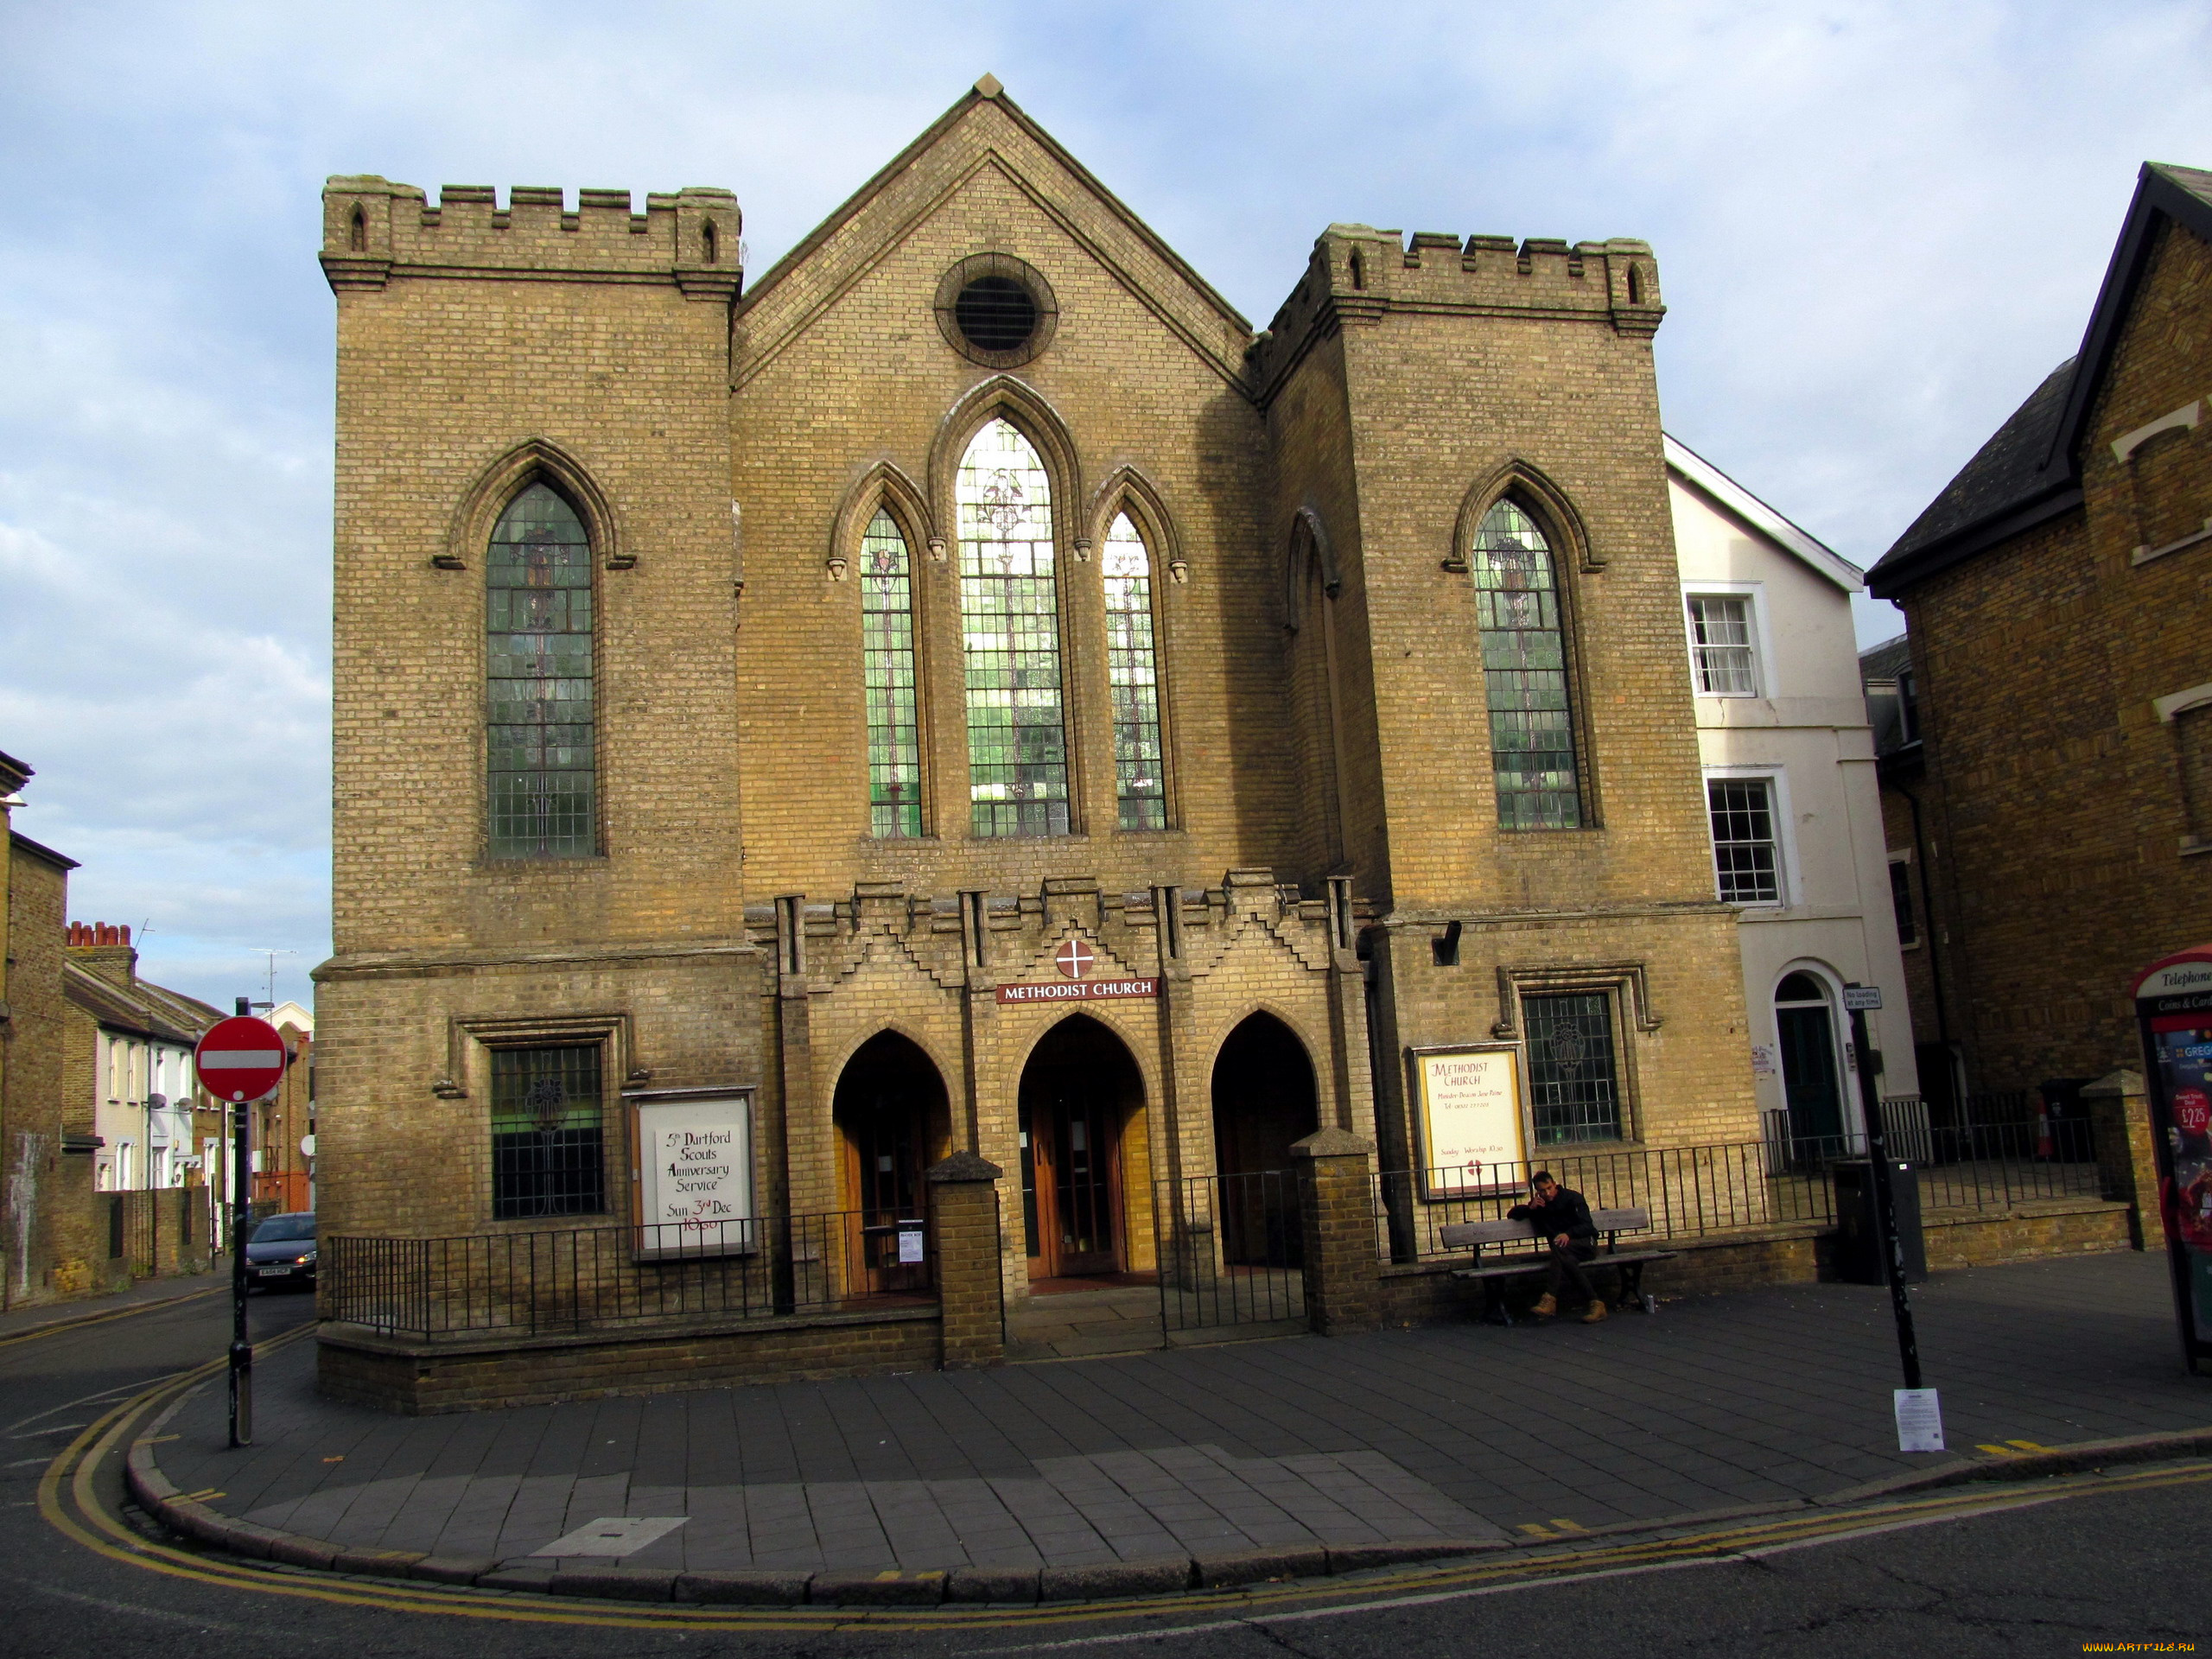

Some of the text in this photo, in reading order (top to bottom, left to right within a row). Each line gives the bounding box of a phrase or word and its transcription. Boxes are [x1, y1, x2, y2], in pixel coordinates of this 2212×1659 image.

[2161, 970, 2212, 987] Telephone
[1005, 982, 1152, 999] METHODIST CHURCH
[1856, 990, 1878, 999] loading
[2158, 1000, 2181, 1011] Coins
[2183, 997, 2190, 1008] &
[1432, 1062, 1490, 1077] METHODIST
[1444, 1076, 1481, 1086] CHURCH
[684, 1130, 731, 1147] Dartford
[680, 1147, 717, 1160] Scouts
[667, 1162, 729, 1179] Anniversary
[676, 1179, 718, 1192] Service
[666, 1203, 688, 1217] Sun
[713, 1200, 732, 1214] Dec
